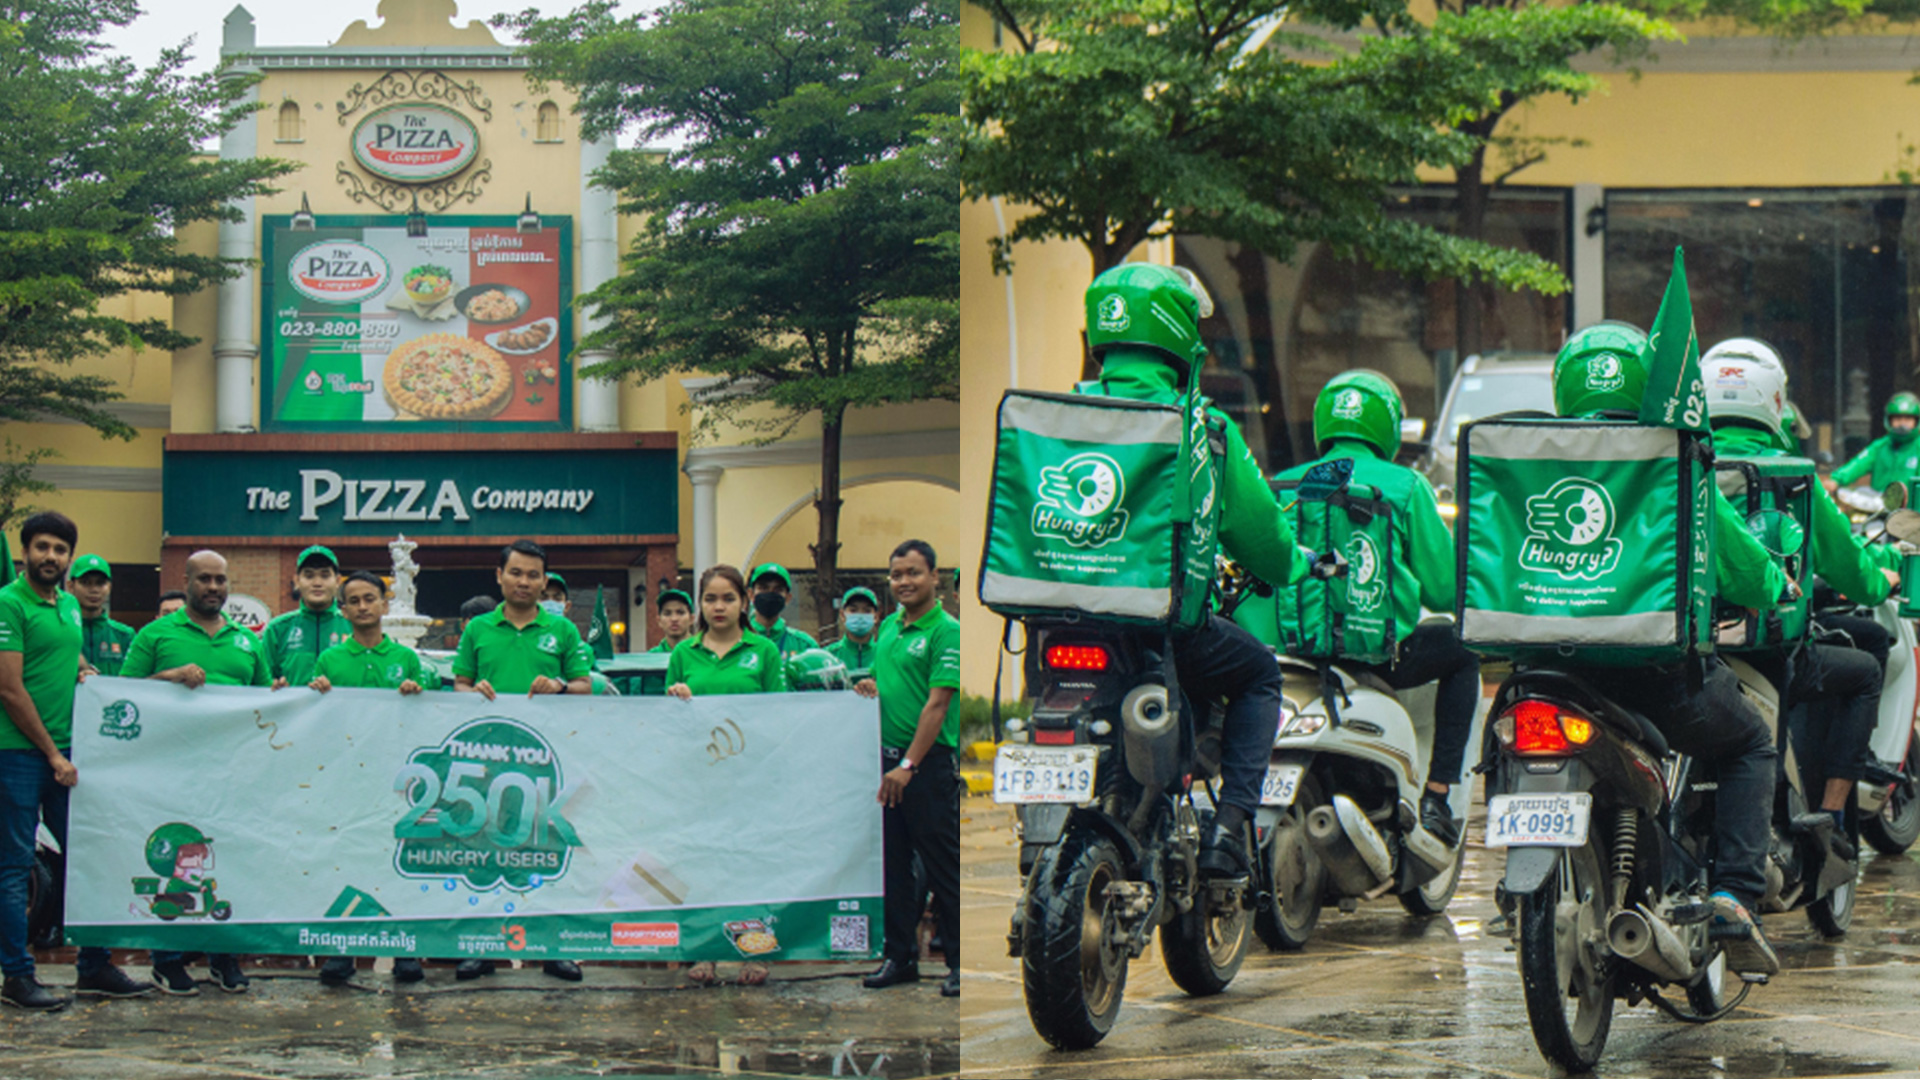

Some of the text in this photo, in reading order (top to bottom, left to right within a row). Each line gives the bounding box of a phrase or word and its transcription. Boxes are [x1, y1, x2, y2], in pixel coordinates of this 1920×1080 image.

[404, 115, 426, 126] The
[375, 123, 454, 148] PIZZA
[388, 152, 442, 164] Company
[331, 249, 352, 259] The
[308, 256, 374, 277] PIZZA
[280, 321, 400, 338] 023-880-880
[246, 469, 594, 521] The PIZZA Company
[1036, 510, 1120, 540] Hungry?
[1527, 543, 1614, 572] Hungry?
[229, 612, 260, 624] ZZA
[450, 740, 552, 765] THANK YOU
[393, 761, 587, 848] 250K
[1497, 813, 1576, 836] 1K-0991
[407, 849, 560, 868] HUNGRY USERS
